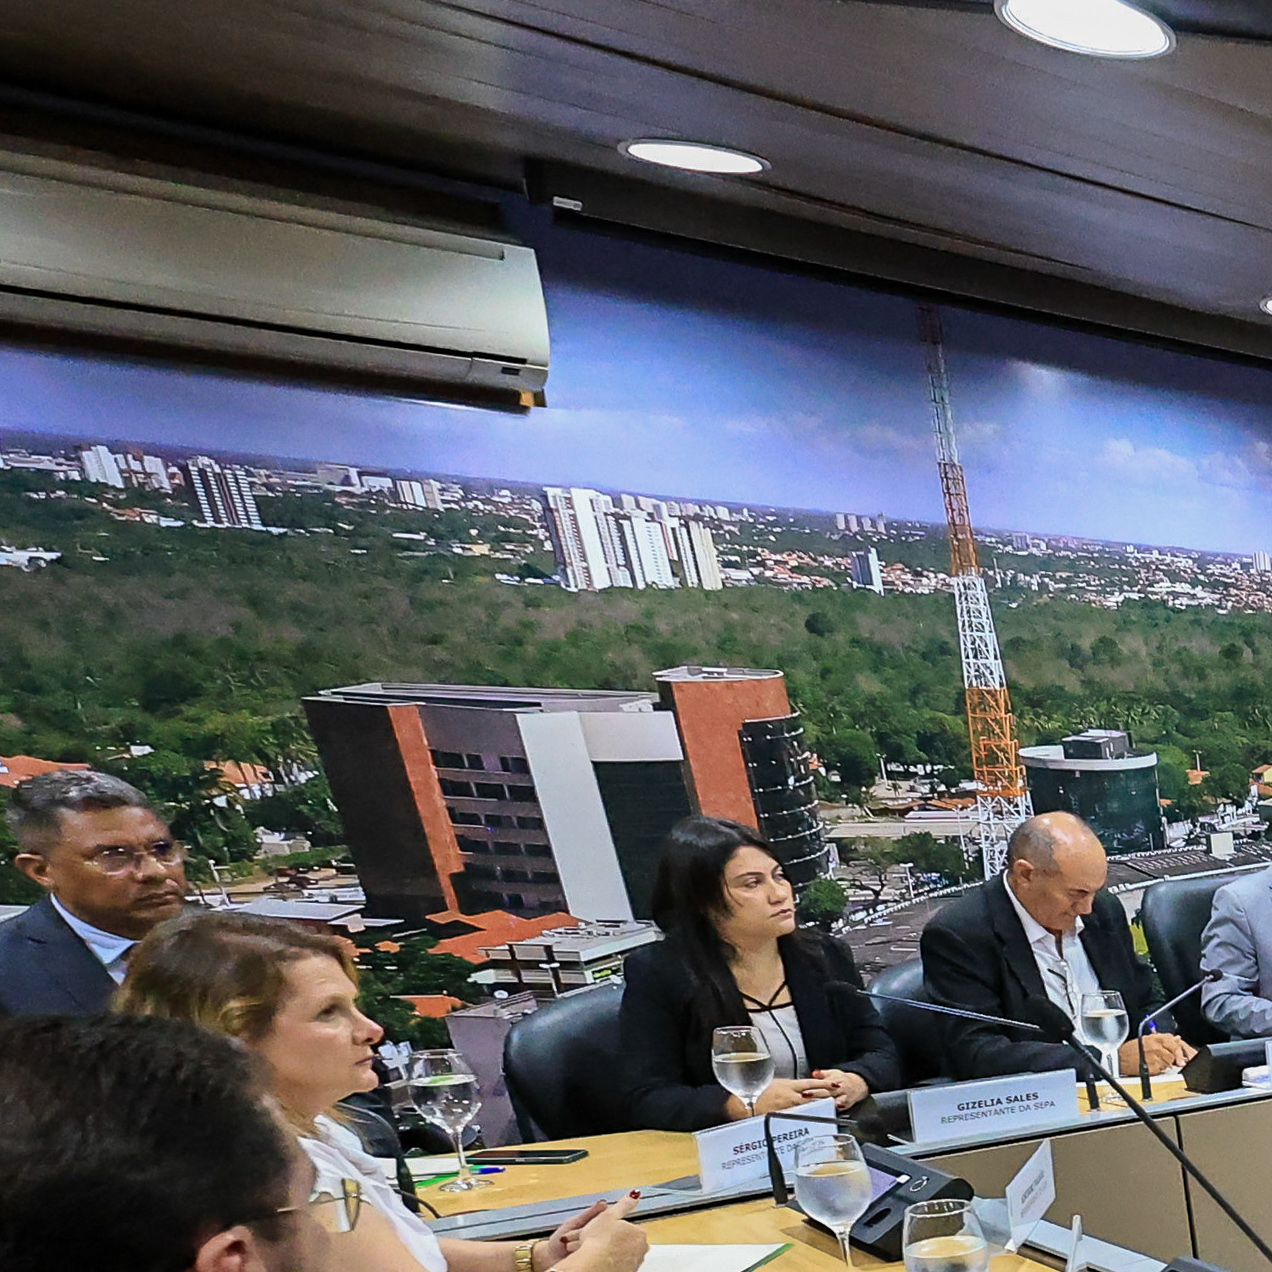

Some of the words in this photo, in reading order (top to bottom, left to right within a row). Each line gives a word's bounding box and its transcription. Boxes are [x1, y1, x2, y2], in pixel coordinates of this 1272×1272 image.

[940, 1105, 1016, 1124] REPRESENTANTE
[1018, 1103, 1031, 1112] DA
[1034, 1100, 1056, 1110] SEPA
[957, 1097, 1003, 1111] GIZELIA
[1005, 1092, 1039, 1104] SALES
[721, 1146, 785, 1170] REPRESENTTE
